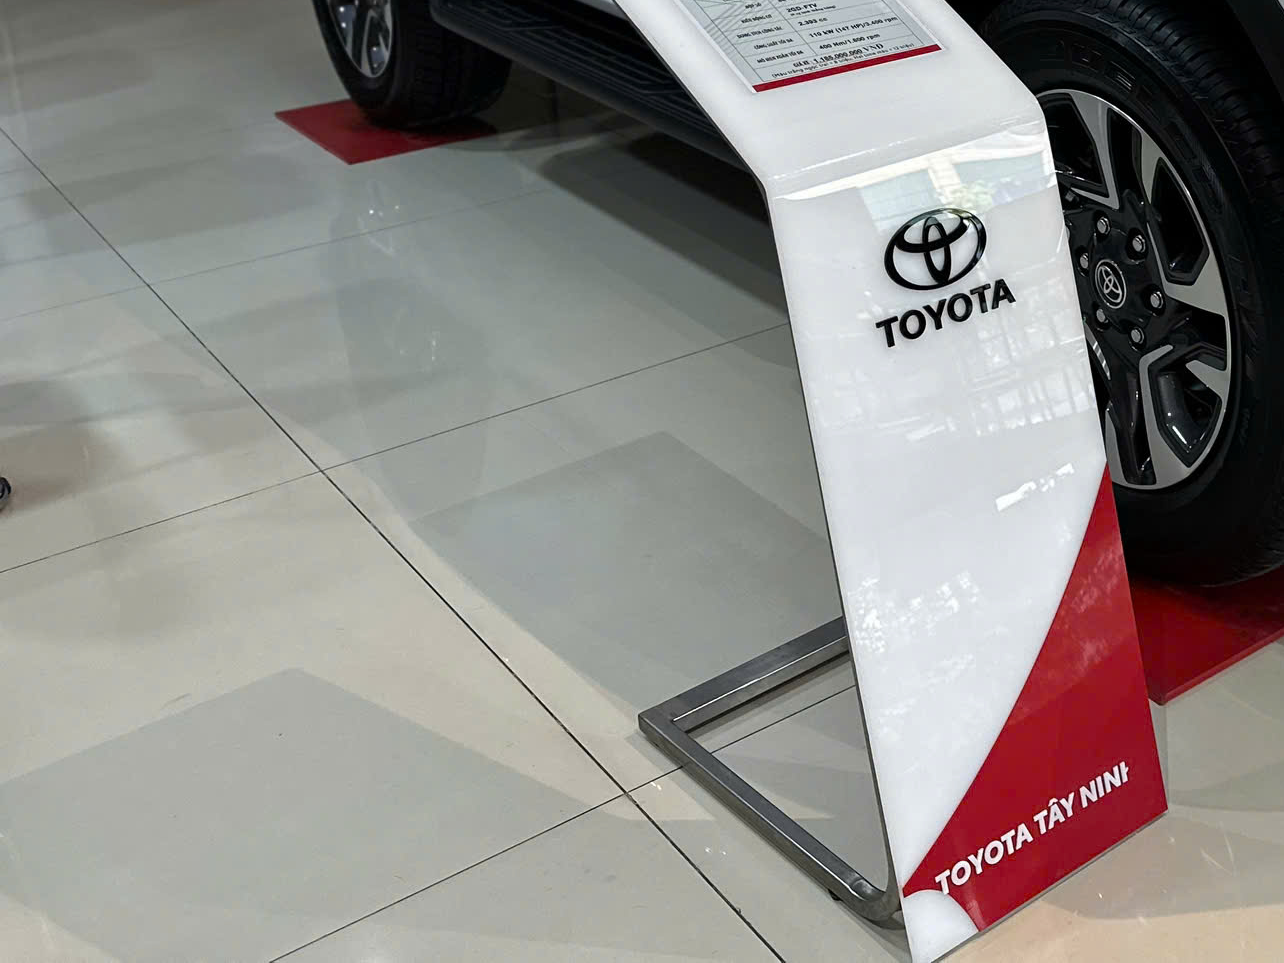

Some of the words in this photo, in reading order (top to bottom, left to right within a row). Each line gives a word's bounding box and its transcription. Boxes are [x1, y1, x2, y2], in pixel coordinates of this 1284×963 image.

[875, 278, 1017, 348] TOYOTA
[935, 823, 1034, 895] TOYOTA
[1033, 792, 1076, 835] TÂY
